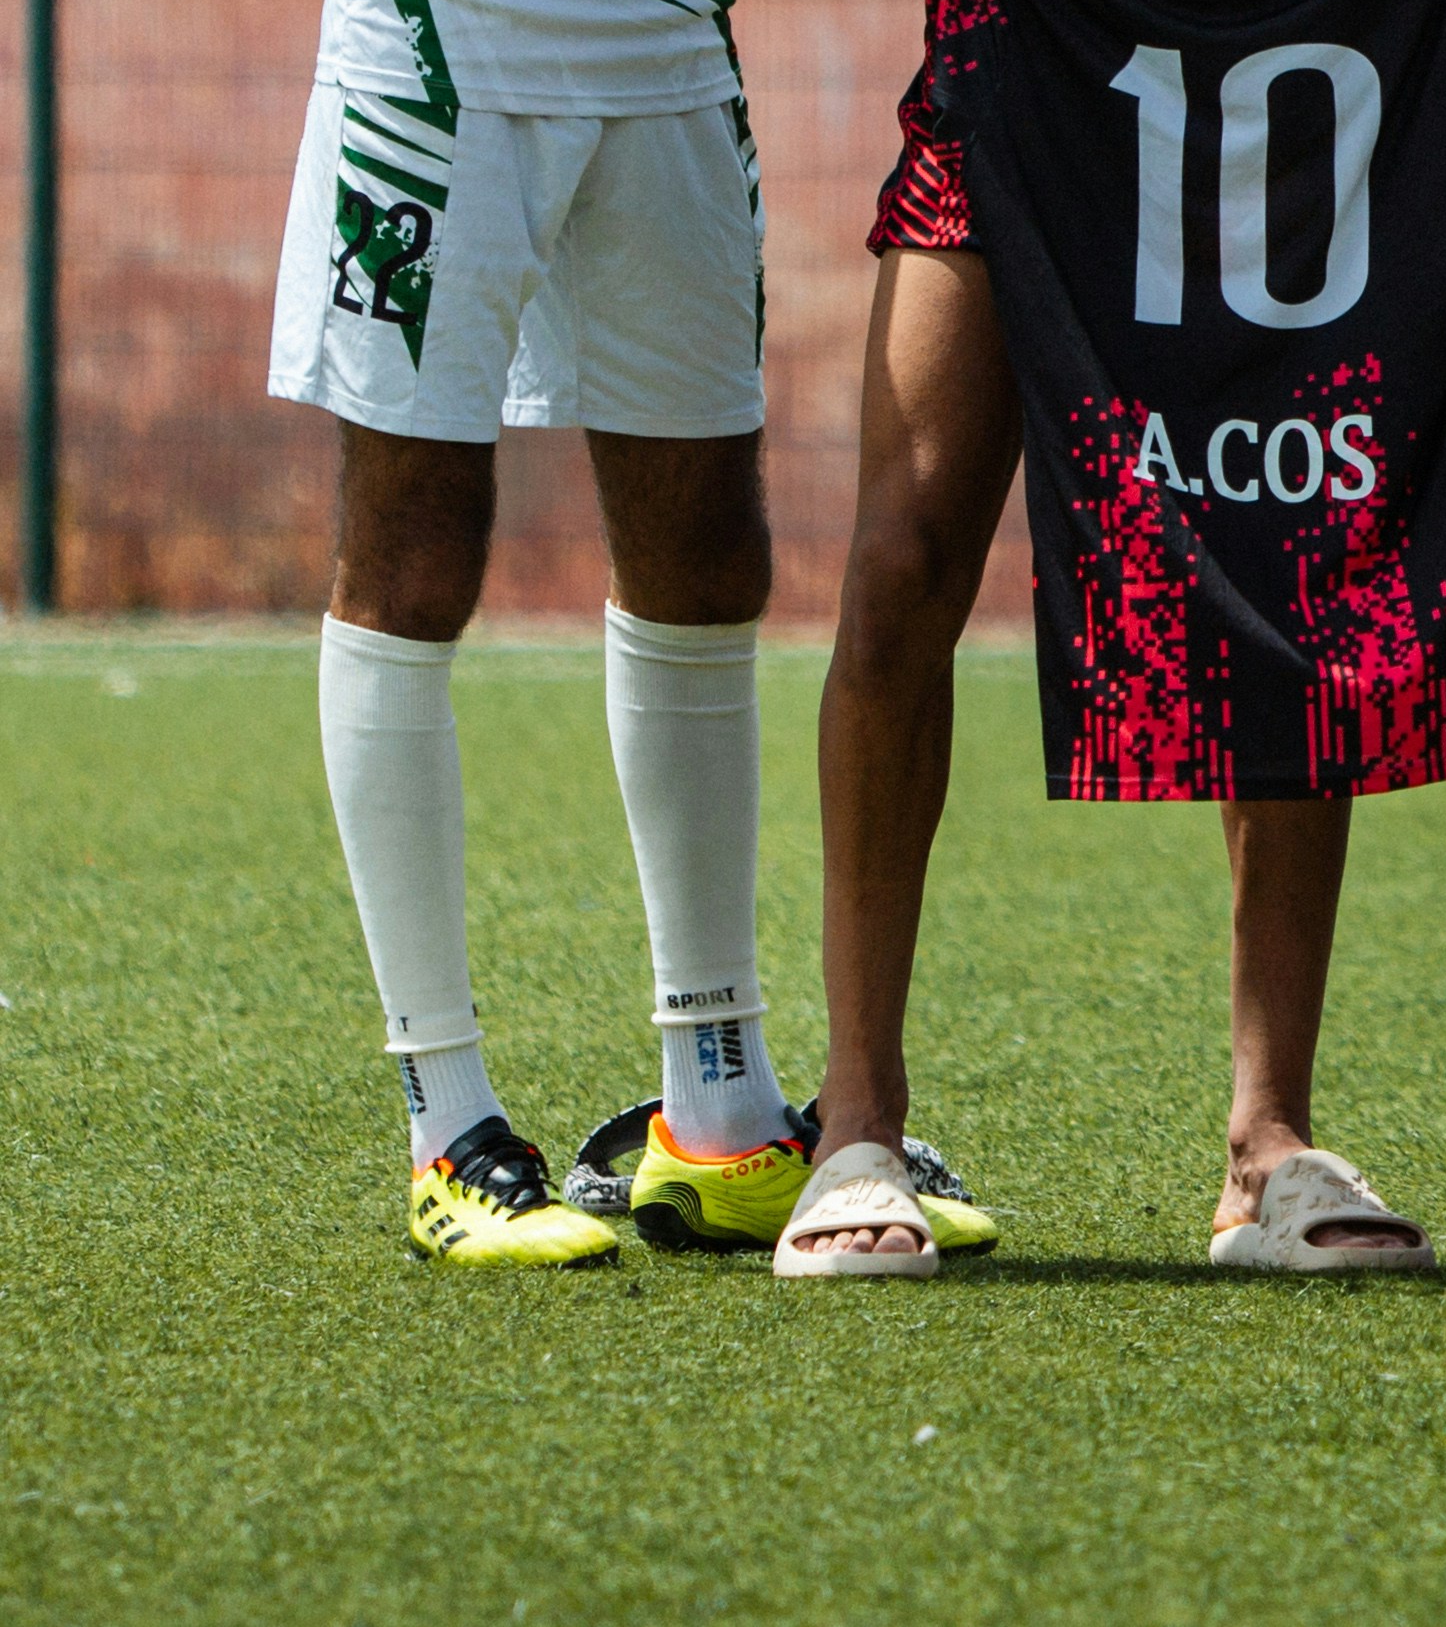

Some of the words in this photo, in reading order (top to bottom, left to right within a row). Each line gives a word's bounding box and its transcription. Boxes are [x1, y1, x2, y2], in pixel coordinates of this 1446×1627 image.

[1108, 43, 1382, 330] 10
[332, 190, 433, 325] 22
[1132, 412, 1378, 503] A.COS
[667, 986, 736, 1010] SPORT
[721, 1155, 777, 1181] COPA
